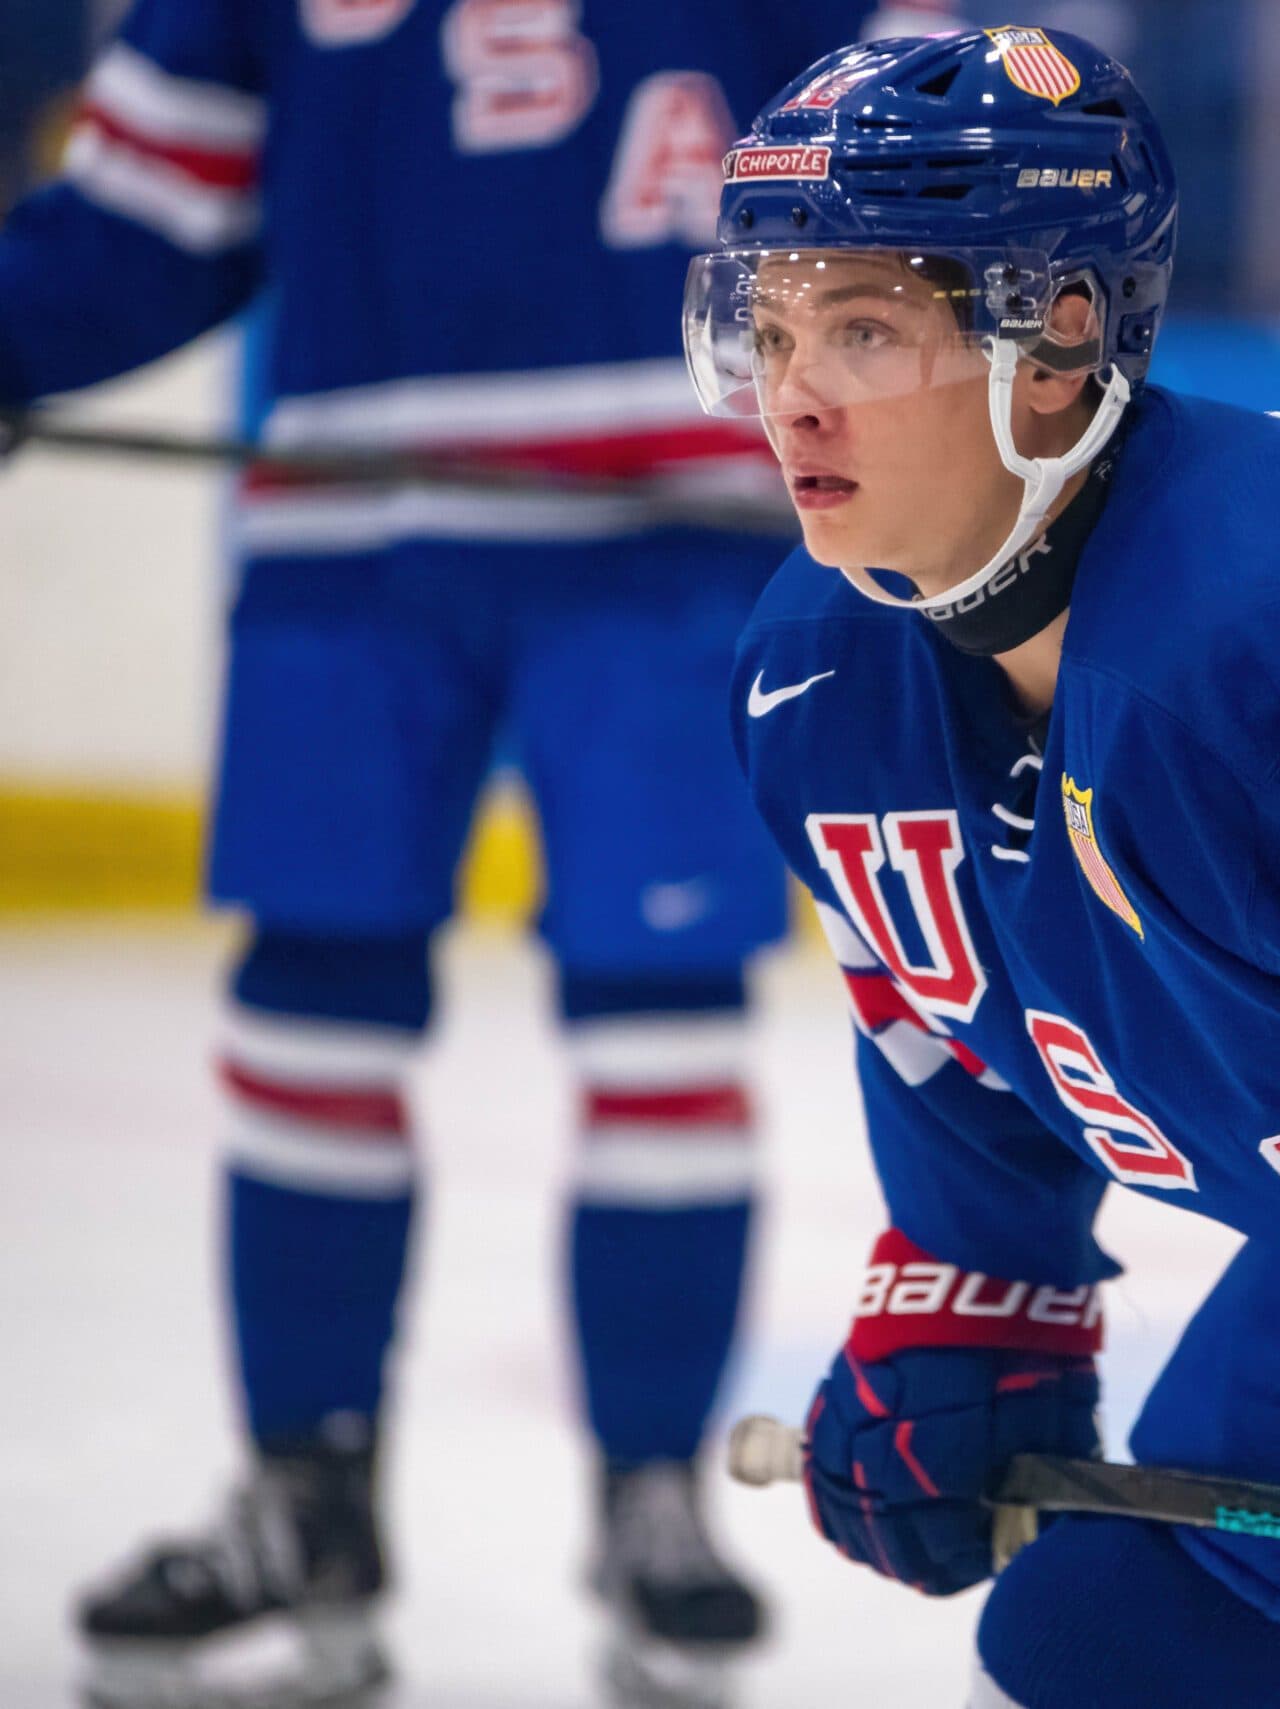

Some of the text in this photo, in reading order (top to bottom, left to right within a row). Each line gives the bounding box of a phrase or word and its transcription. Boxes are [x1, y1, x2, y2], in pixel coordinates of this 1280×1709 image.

[739, 152, 823, 172] CHIPOTLE
[1016, 168, 1112, 188] BAUER
[1000, 317, 1043, 329] BAUER
